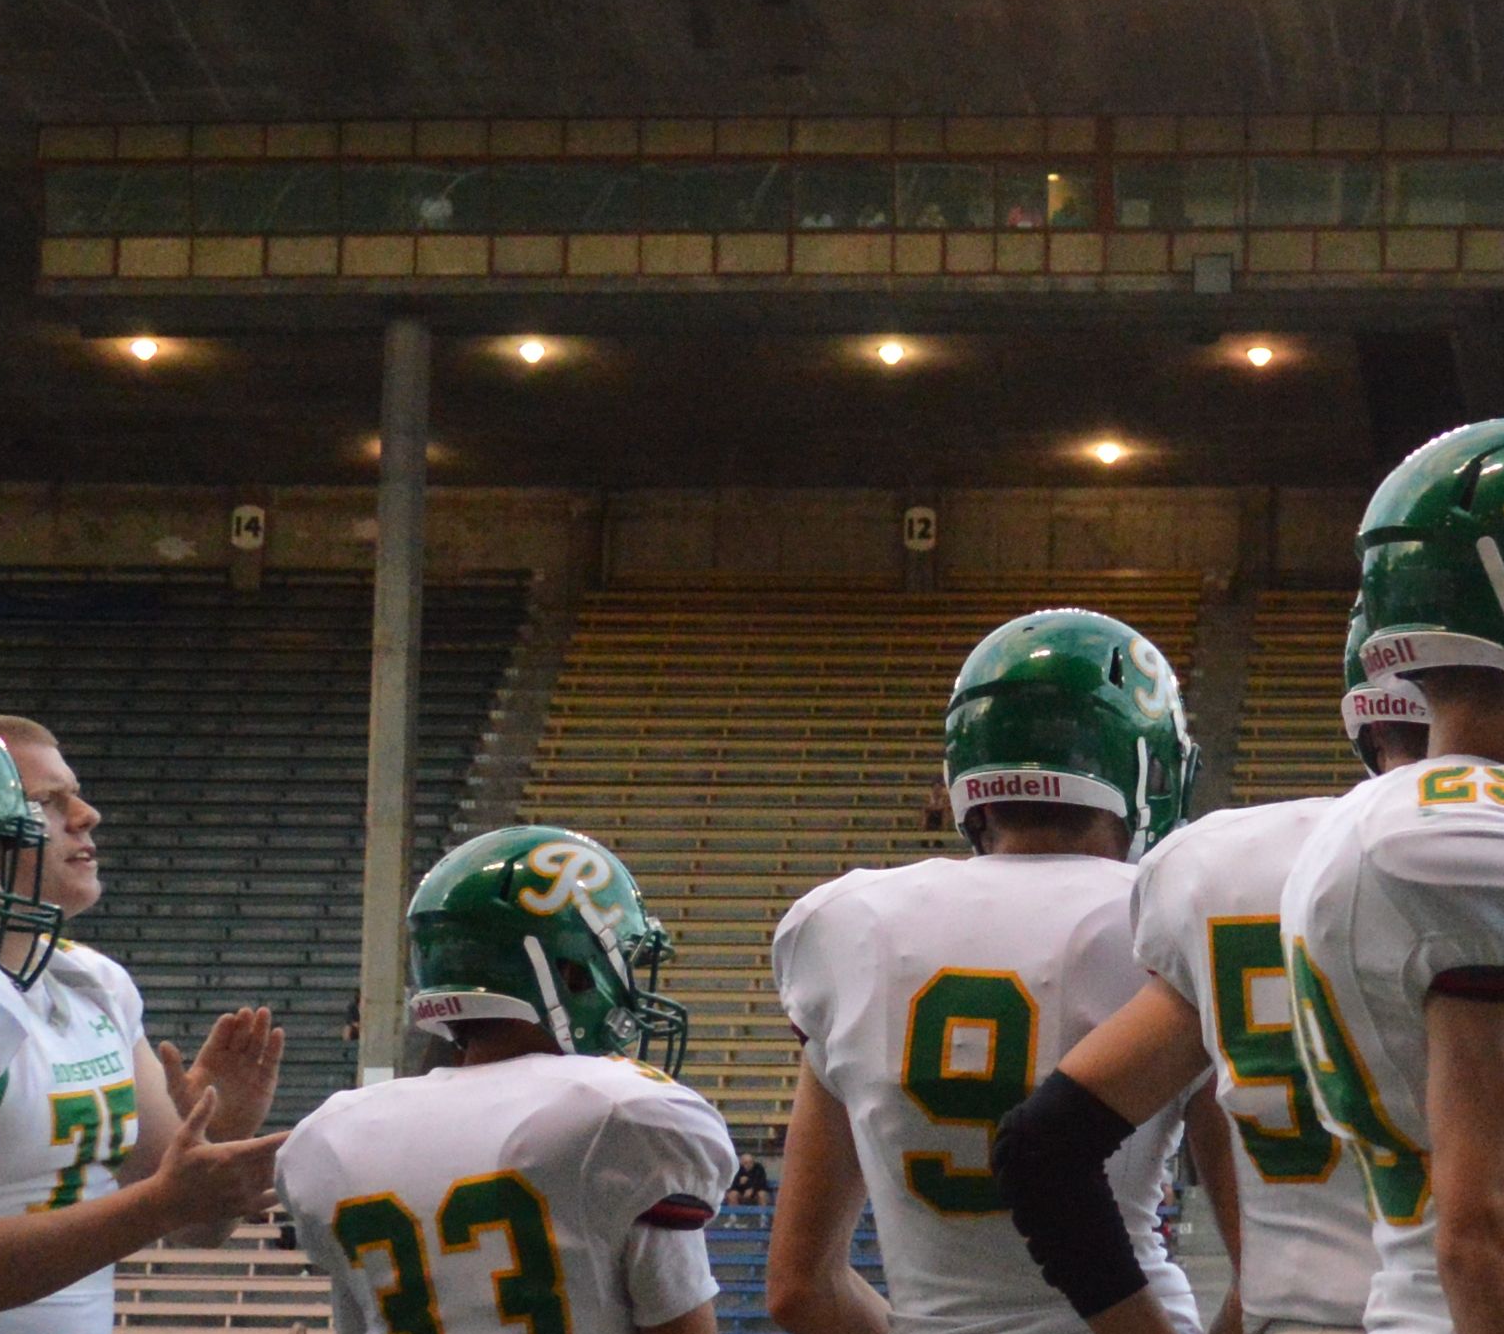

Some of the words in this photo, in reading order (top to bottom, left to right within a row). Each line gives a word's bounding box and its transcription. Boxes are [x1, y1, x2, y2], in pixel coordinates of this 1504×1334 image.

[236, 516, 262, 537] 14
[907, 517, 933, 539] 12
[966, 774, 1061, 801] Riddell
[901, 966, 1039, 1217] 9
